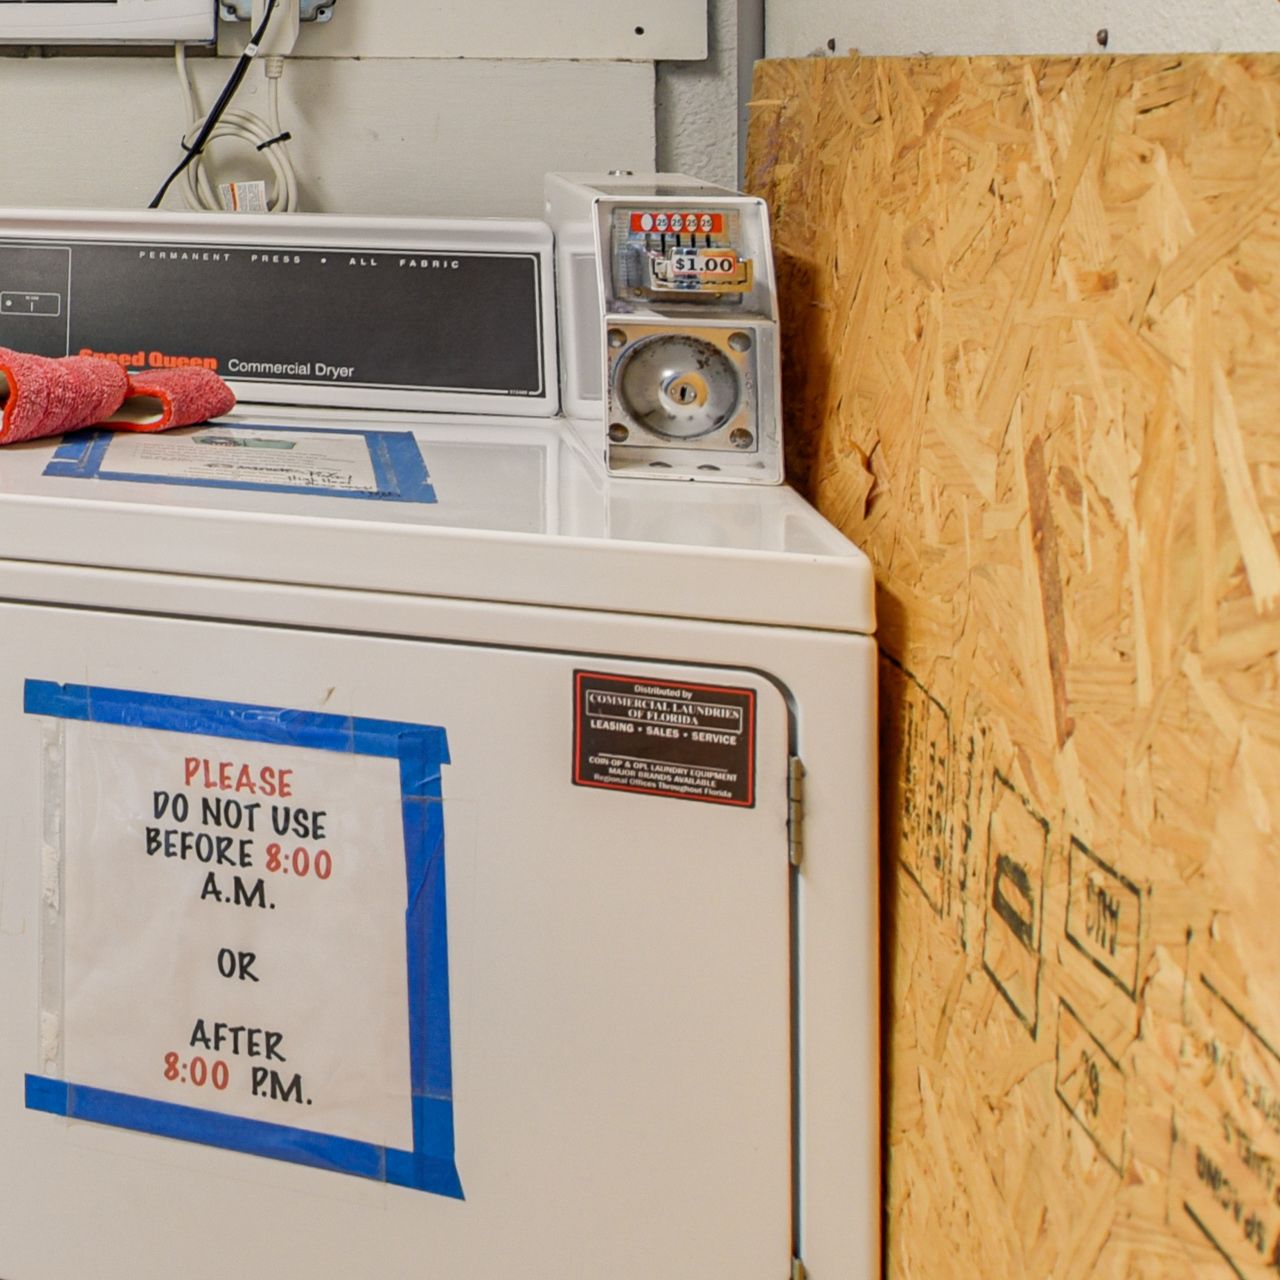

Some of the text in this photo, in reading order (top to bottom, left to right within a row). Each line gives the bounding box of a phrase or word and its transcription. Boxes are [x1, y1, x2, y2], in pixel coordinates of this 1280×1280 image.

[139, 251, 461, 269] PERMANENT PRESS ALL FABRIC
[675, 256, 733, 272] $1.00
[148, 351, 218, 370] Queen
[228, 358, 311, 376] Commercial
[315, 362, 355, 380] Dryer
[634, 684, 693, 700] Distributed by
[589, 693, 740, 719] COMMERCIAL LAUNDRIES
[628, 709, 699, 726] OF FLORIDA
[590, 719, 737, 746] LEASING SALES SERVICE
[184, 757, 293, 798] PLEASE
[594, 773, 733, 798] Regional Throughout Florida
[608, 767, 717, 788] MAJOR BRANDS AVAILABLE
[650, 763, 737, 782] LAUNDRY EQUIPMENT
[153, 790, 327, 840] DO NOT USE
[145, 826, 332, 880] BEFORE 8:00
[200, 871, 276, 910] A.M.
[217, 948, 260, 982] OR
[189, 1018, 287, 1063] AFTER
[163, 1051, 313, 1105] 8:00 P.M.
